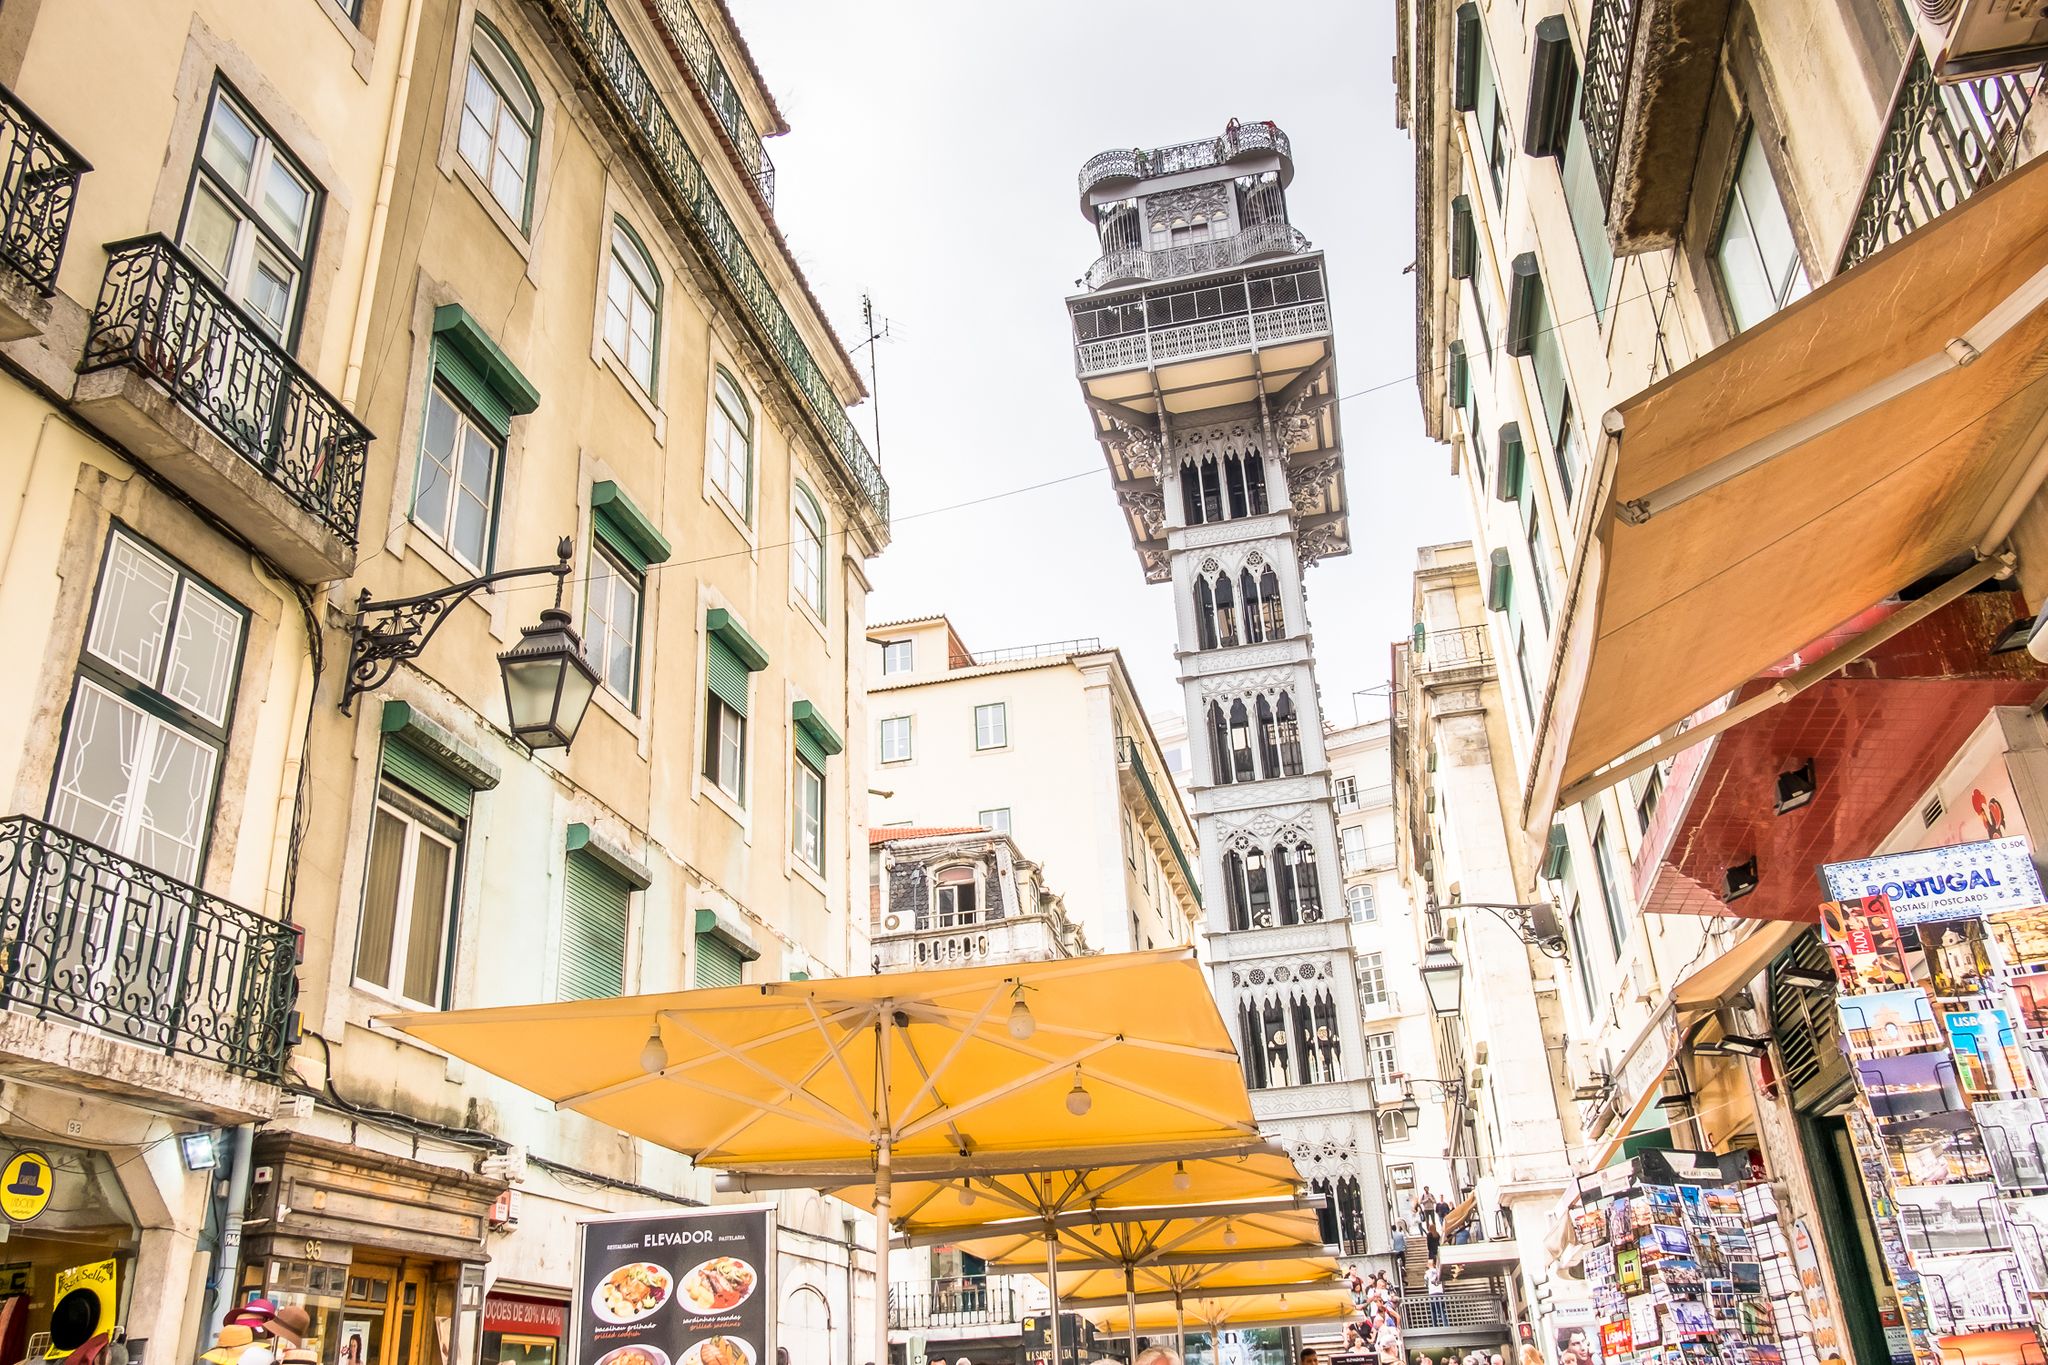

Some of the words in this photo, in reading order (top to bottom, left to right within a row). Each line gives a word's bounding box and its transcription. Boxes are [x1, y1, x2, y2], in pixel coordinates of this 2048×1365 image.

[2001, 840, 2026, 850] 0.50€
[1866, 868, 2001, 901] PORTUGAL
[1892, 893, 1989, 913] OSTAIS//POSTCARDS
[1852, 931, 1870, 954] FADO
[69, 1122, 82, 1134] 93
[606, 1243, 640, 1251] RESTAURANTE
[644, 1230, 713, 1248] ELEVADOR
[718, 1234, 746, 1242] PASTELARIA
[305, 1240, 322, 1260] 95
[81, 1269, 108, 1284] Seller
[512, 1304, 523, 1322] DE
[524, 1306, 539, 1324] 20%
[540, 1308, 546, 1325] A
[546, 1307, 561, 1326] 40%
[682, 1315, 716, 1325] sardinhas
[716, 1314, 742, 1322] assadas
[594, 1325, 627, 1333] bacalhau
[626, 1322, 657, 1333] grelhado
[689, 1323, 713, 1332] grilled
[713, 1321, 741, 1330] sardines
[593, 1332, 617, 1341] grilled
